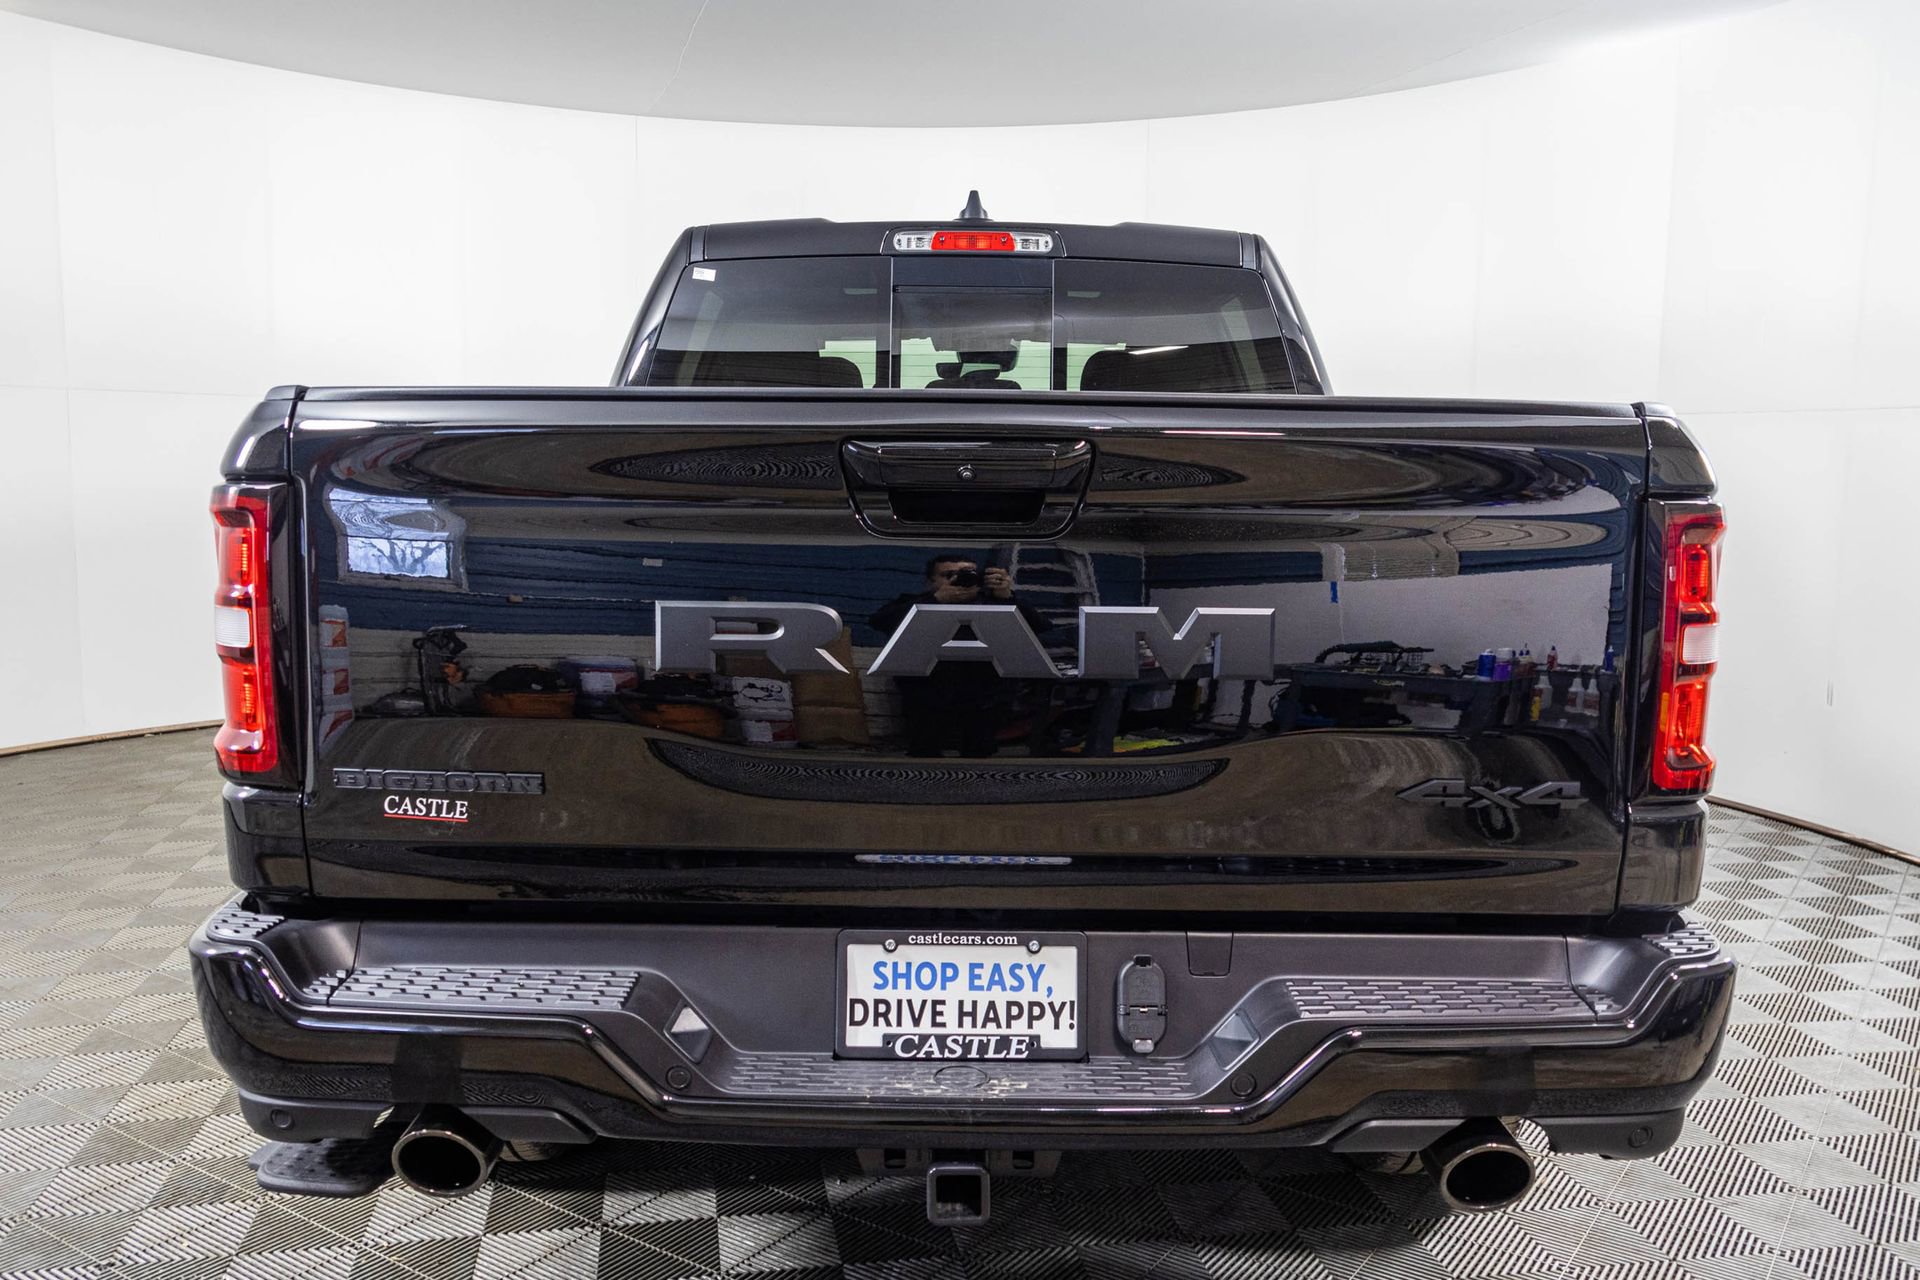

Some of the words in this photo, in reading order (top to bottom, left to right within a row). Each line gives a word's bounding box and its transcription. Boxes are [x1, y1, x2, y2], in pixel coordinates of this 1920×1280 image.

[655, 600, 1276, 679] RAM
[383, 795, 469, 819] CASTLE
[908, 932, 1018, 946] castlecars.com
[873, 960, 959, 991] SHOP
[968, 962, 1054, 998] EASY,
[849, 998, 947, 1028] DRIVE
[957, 1000, 1076, 1031] HAPPY!
[894, 1035, 1030, 1059] CASTLE
